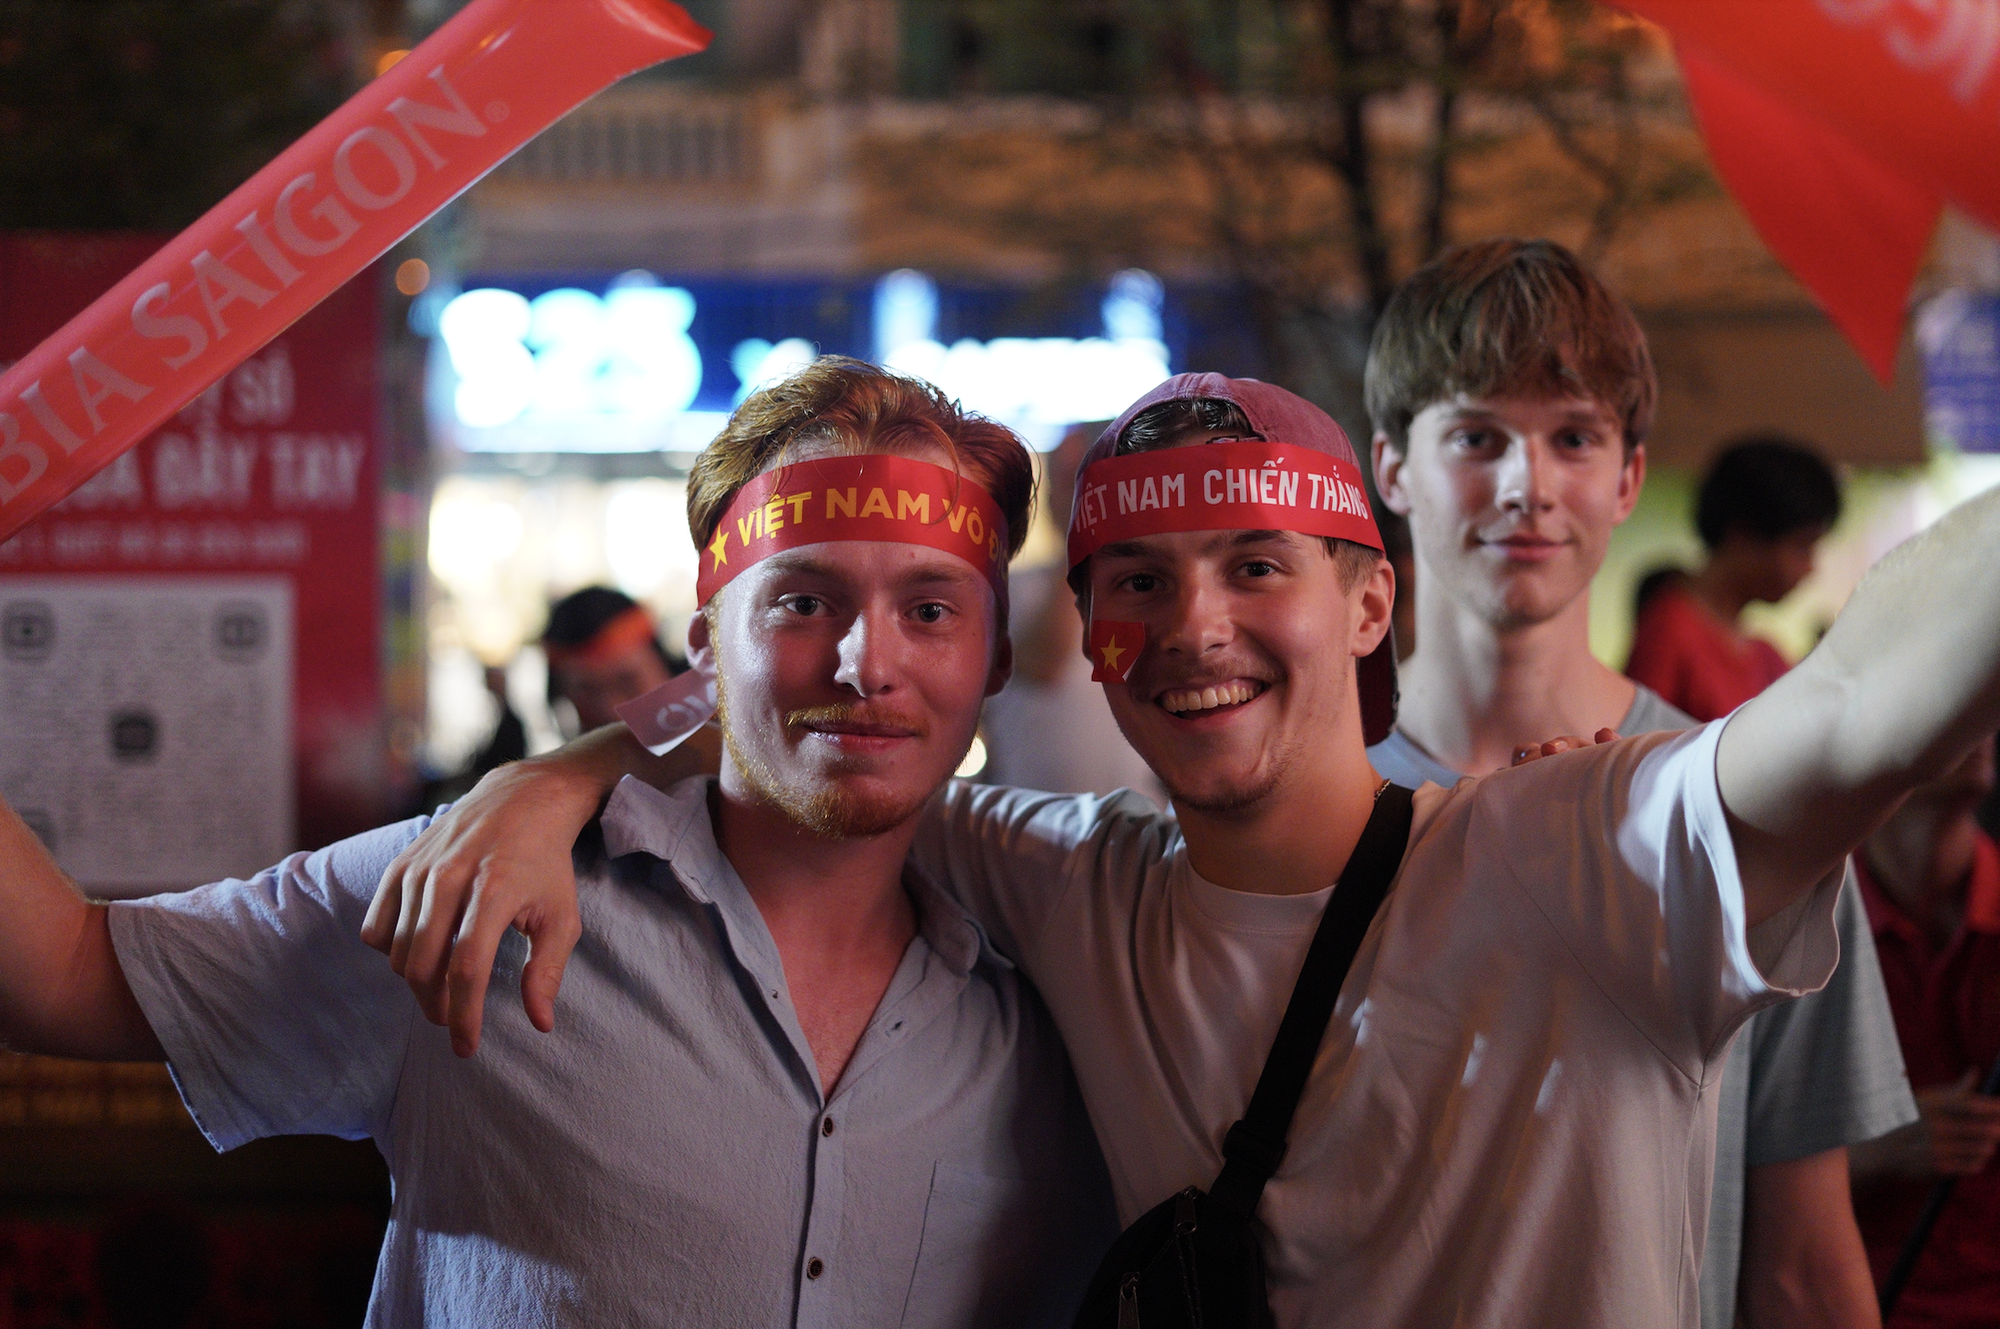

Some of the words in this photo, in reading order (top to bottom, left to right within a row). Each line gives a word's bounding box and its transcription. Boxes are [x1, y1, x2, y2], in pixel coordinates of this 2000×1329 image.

[0, 345, 155, 505] BIA
[132, 66, 488, 371] SAIGON
[737, 491, 812, 547] VIỆT
[826, 487, 930, 524] NAM
[942, 498, 984, 545] VÔ
[1117, 473, 1186, 515] NAM
[1203, 457, 1300, 507] CHIẾN
[1307, 465, 1369, 520] THẮNG
